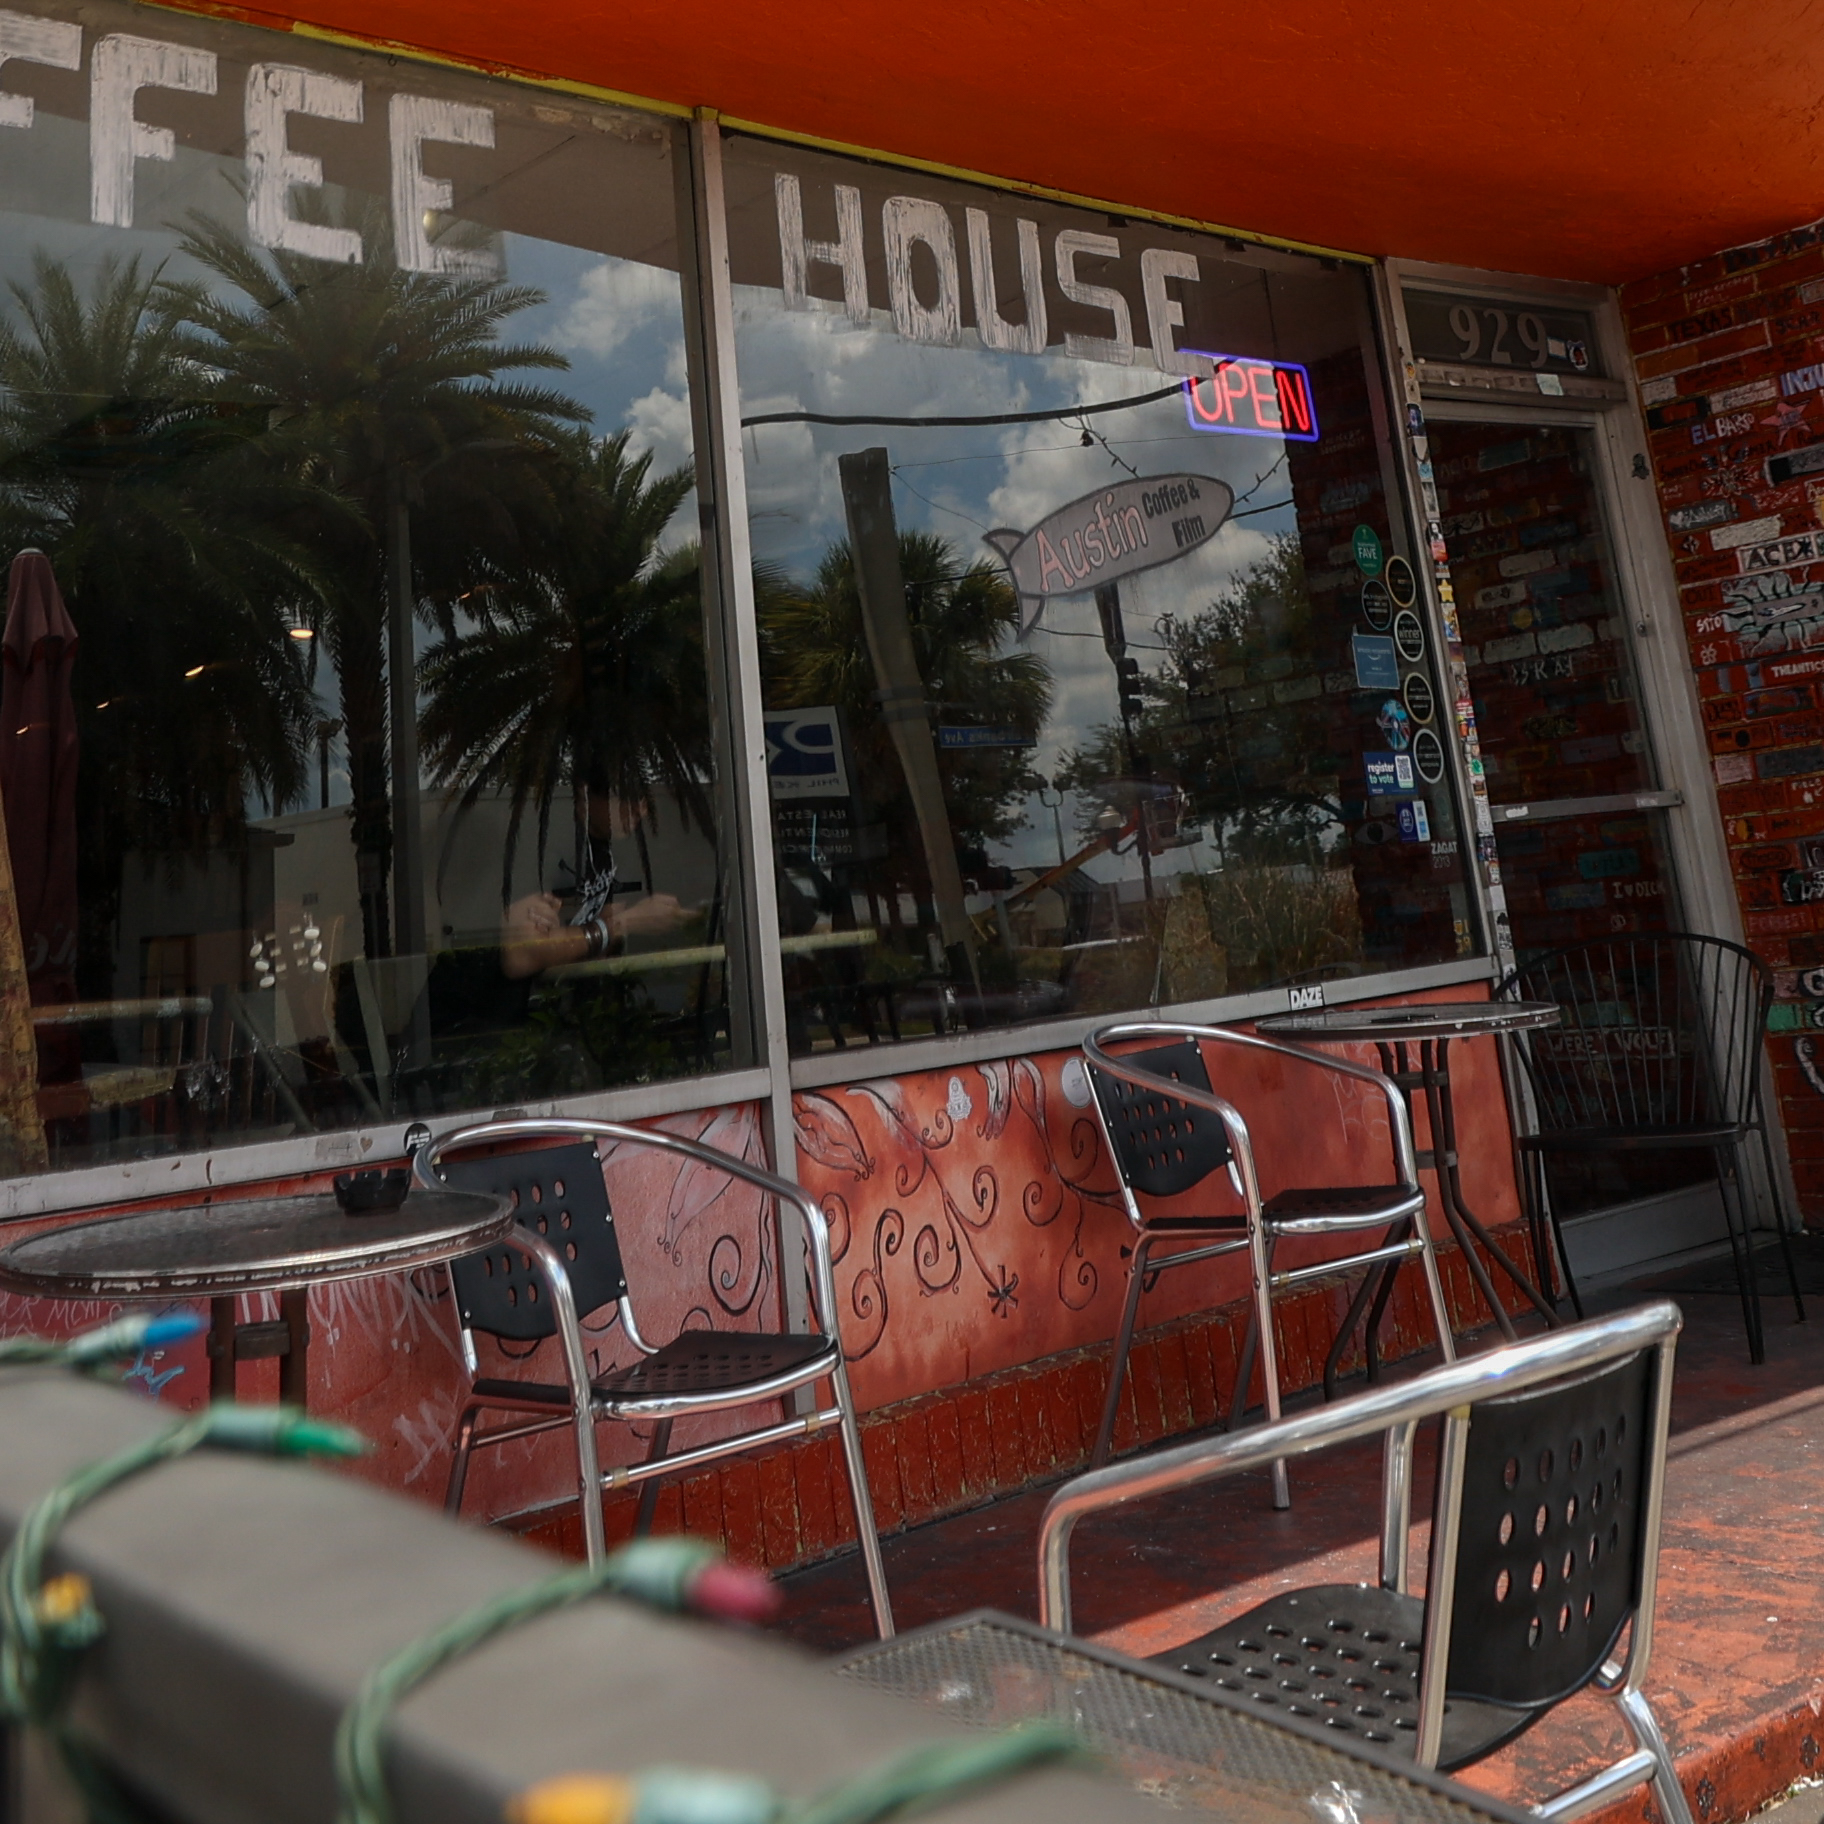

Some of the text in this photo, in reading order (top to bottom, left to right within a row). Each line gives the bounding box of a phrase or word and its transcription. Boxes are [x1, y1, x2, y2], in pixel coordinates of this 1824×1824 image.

[777, 173, 1215, 379] HOUSE
[1449, 304, 1548, 368] 929
[1188, 363, 1311, 433] OPEN
[1691, 423, 1717, 445] EL
[1035, 478, 1200, 593] Austin Coffee &
[1171, 515, 1206, 548] Film
[1358, 547, 1378, 560] FAVE
[1398, 628, 1421, 639] winner
[1367, 761, 1395, 777] register
[1369, 774, 1394, 784] to vote
[1431, 841, 1458, 855] ZAGAT
[1433, 856, 1451, 869] 2013
[1613, 881, 1625, 899] I
[1289, 985, 1323, 1010] DAZE
